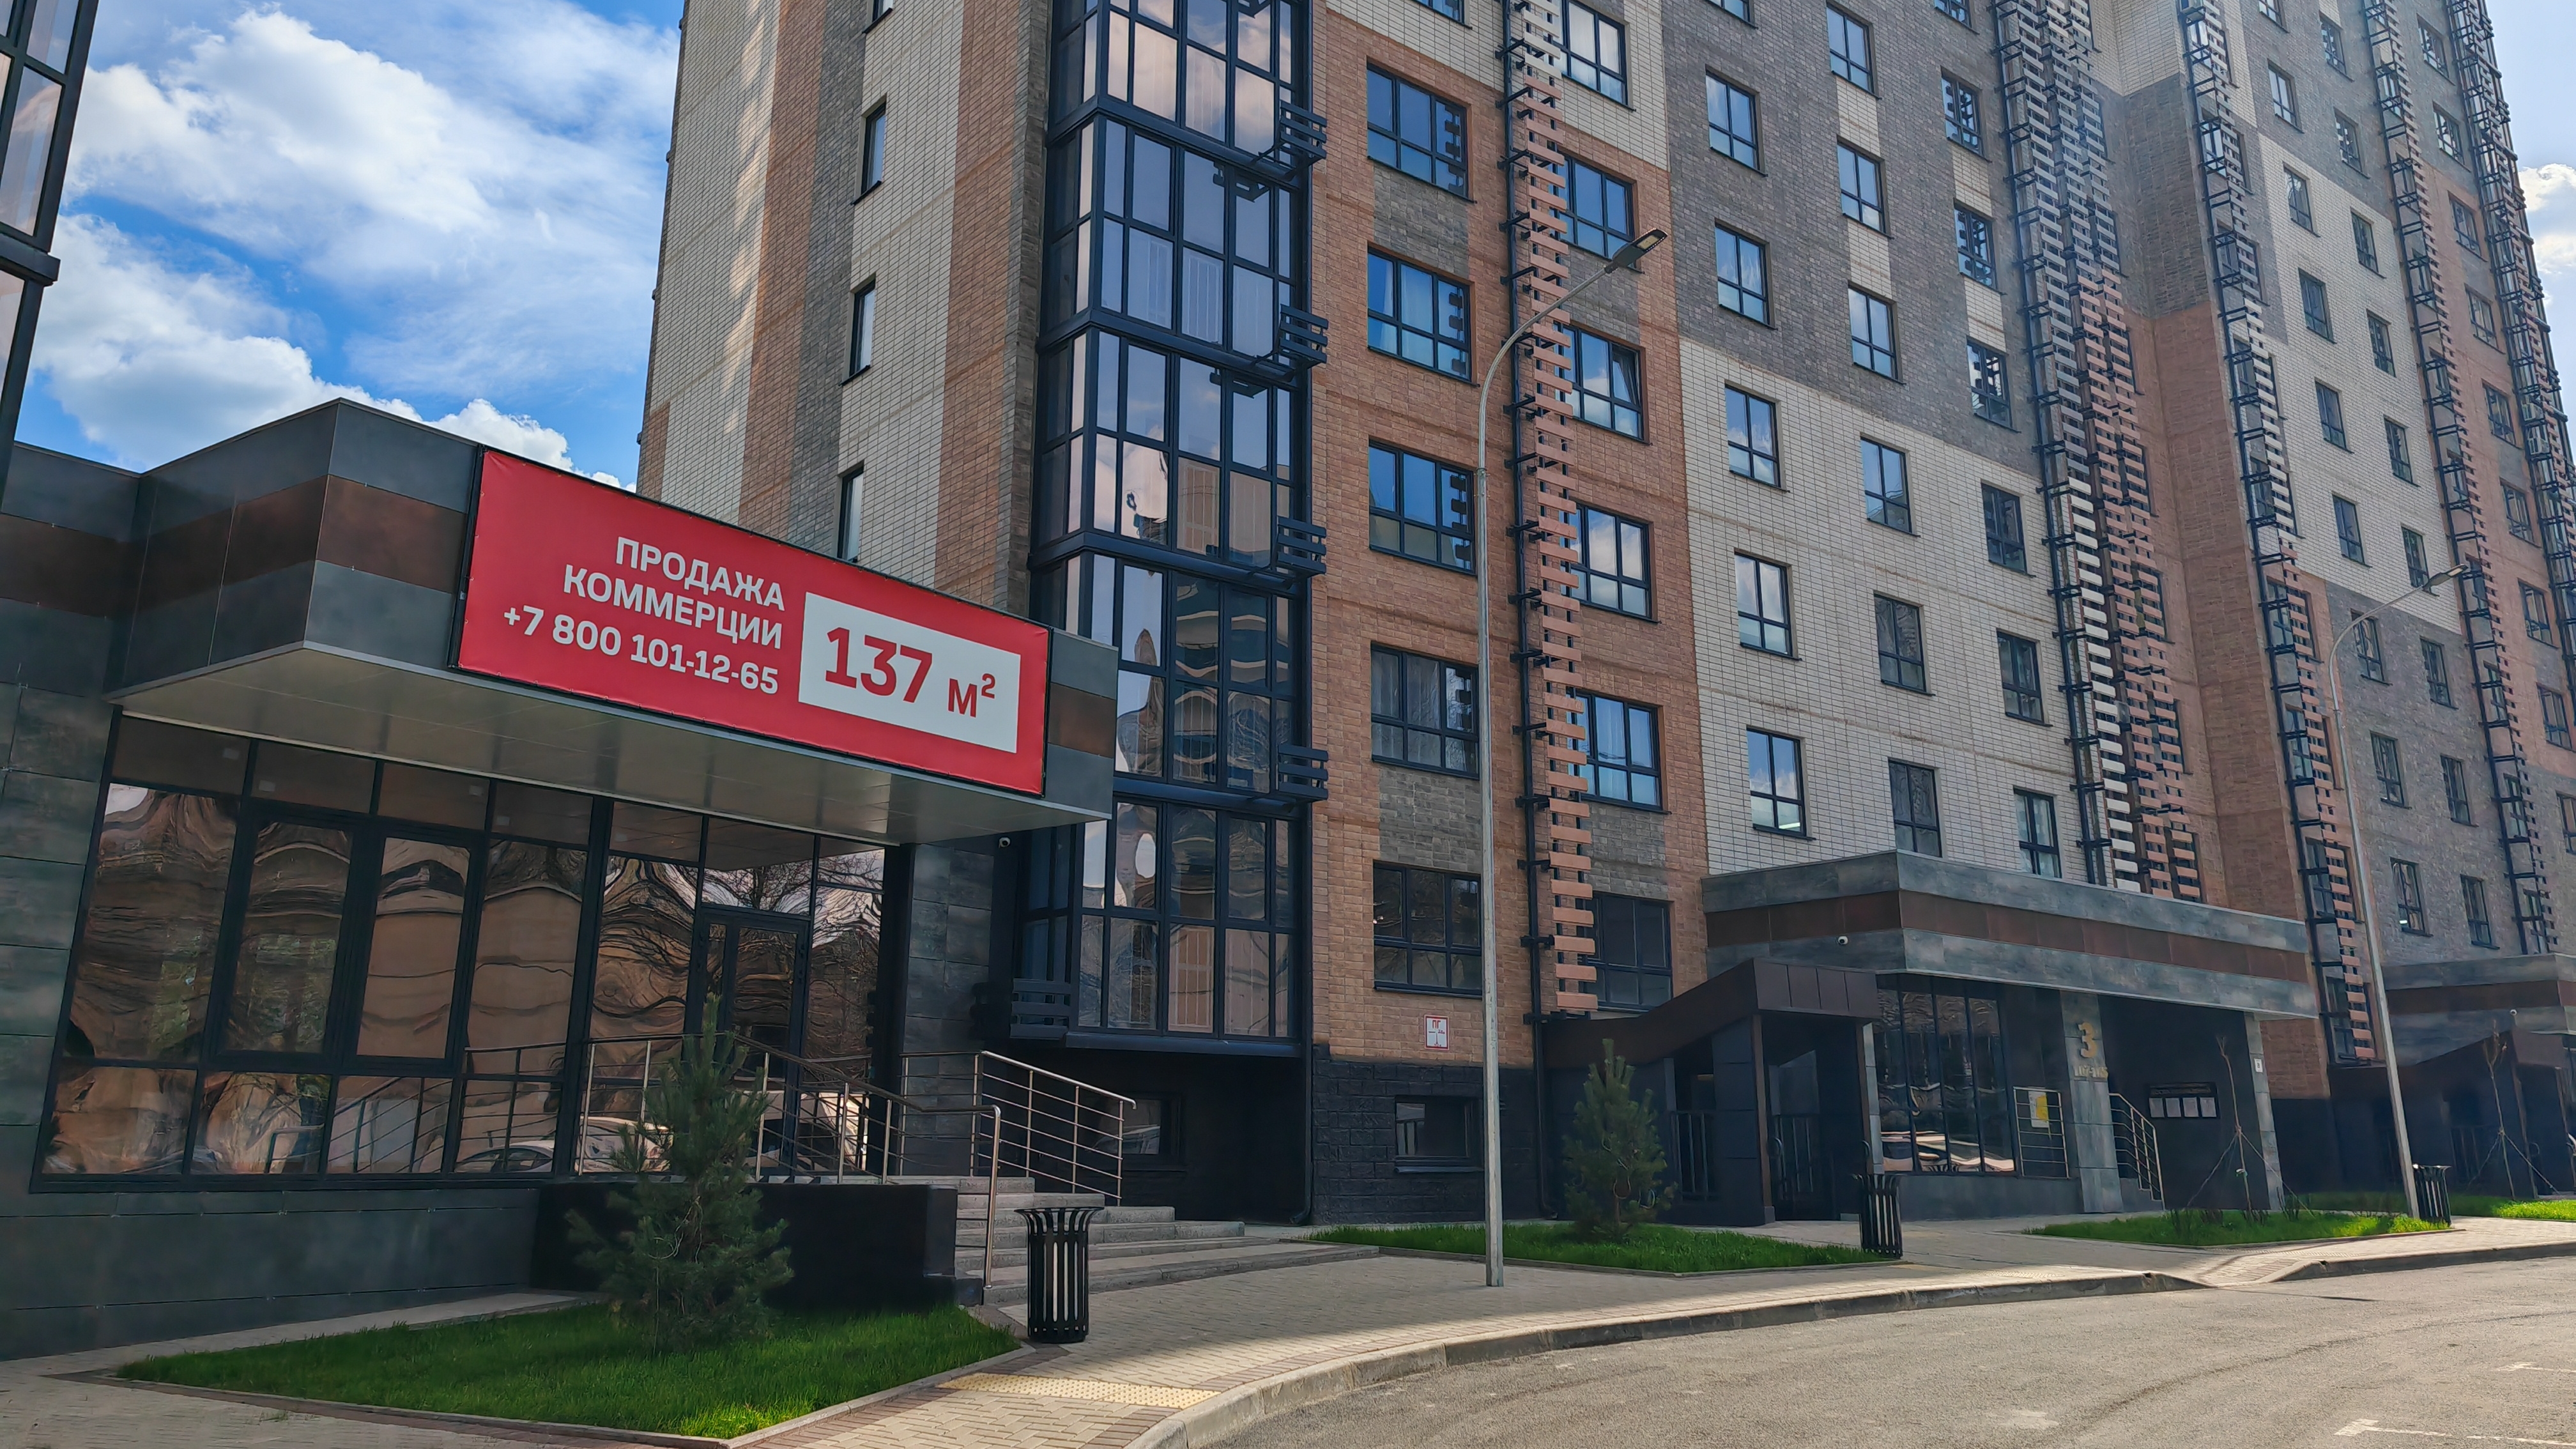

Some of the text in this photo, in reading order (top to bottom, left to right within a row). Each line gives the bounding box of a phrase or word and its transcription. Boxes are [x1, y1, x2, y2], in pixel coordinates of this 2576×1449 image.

[564, 564, 783, 650] КОММЕРЦИИ
[616, 537, 785, 611] ПРОДАЖА
[503, 605, 779, 694] +7 800 101-12-65
[825, 626, 933, 704] 137
[1432, 1020, 1441, 1029] ПГ
[2078, 1022, 2097, 1058] 3
